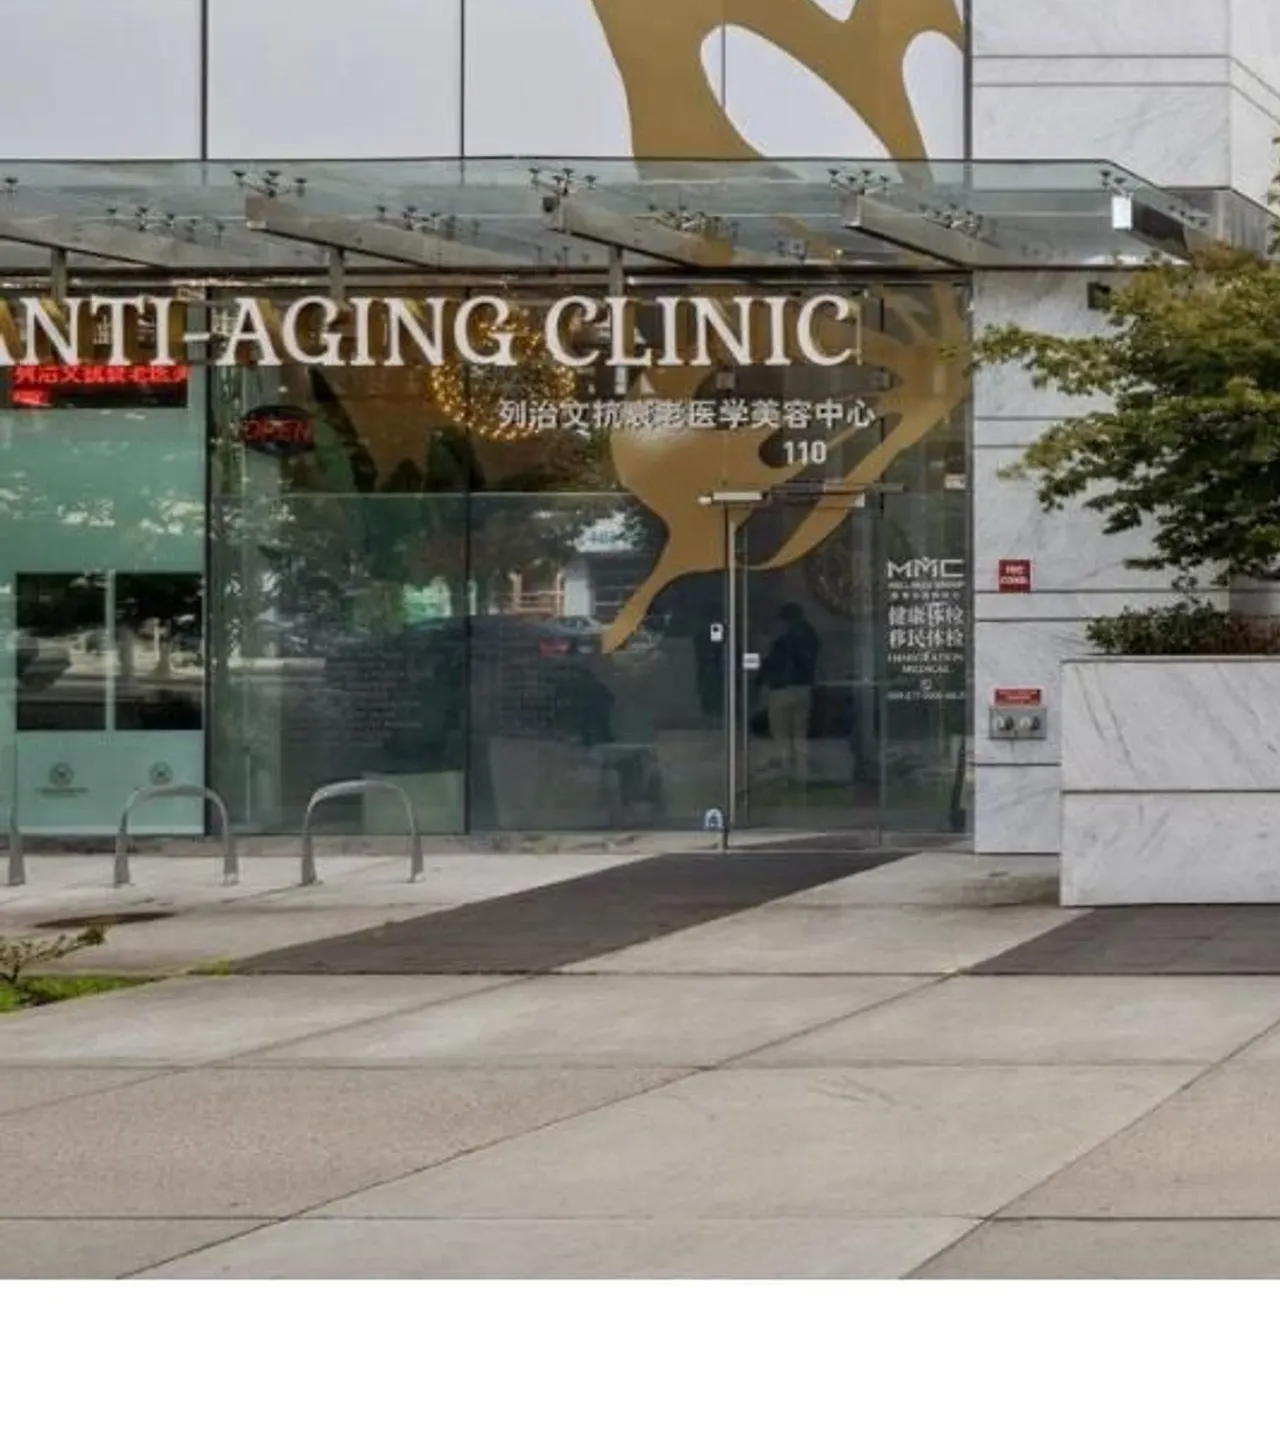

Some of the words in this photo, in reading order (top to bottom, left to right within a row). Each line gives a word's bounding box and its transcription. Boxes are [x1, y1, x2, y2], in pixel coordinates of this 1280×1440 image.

[0, 294, 517, 366] NTI-AGING
[545, 294, 853, 366] CLINIC
[243, 417, 308, 442] OPEN
[783, 441, 827, 465] 110
[887, 556, 965, 578] MMC
